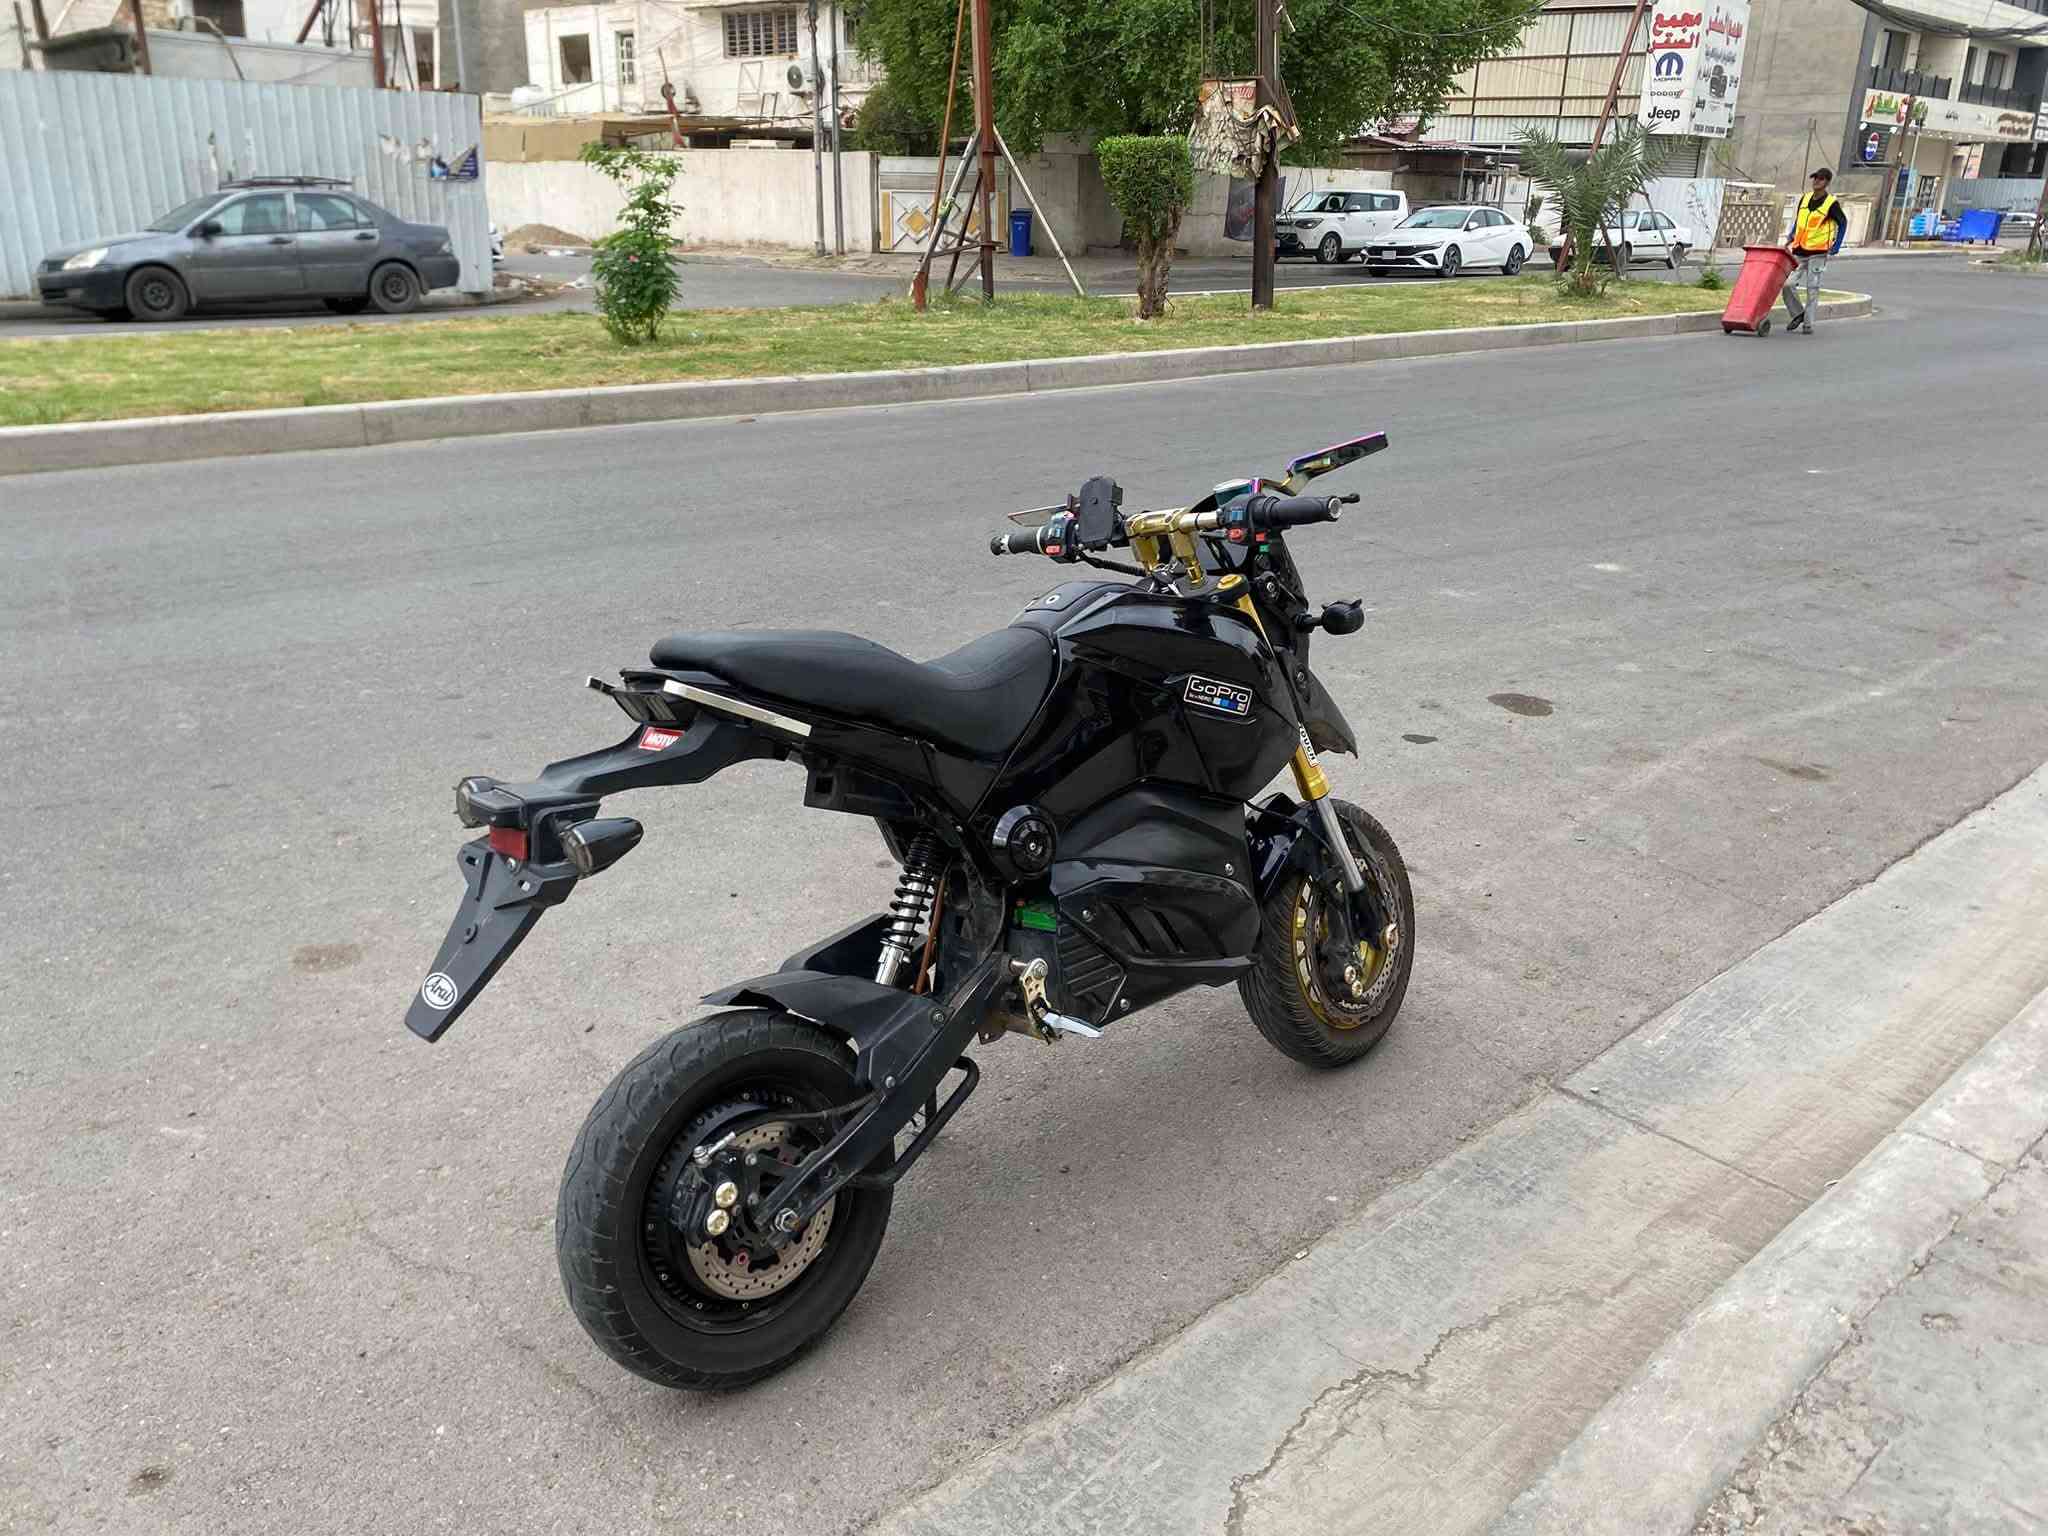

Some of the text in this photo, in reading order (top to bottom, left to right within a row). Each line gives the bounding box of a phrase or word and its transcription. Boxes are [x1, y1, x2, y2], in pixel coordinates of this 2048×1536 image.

[1653, 12, 1702, 36] مجمع
[1647, 106, 1681, 122] Jeep
[1190, 680, 1249, 703] GoPro
